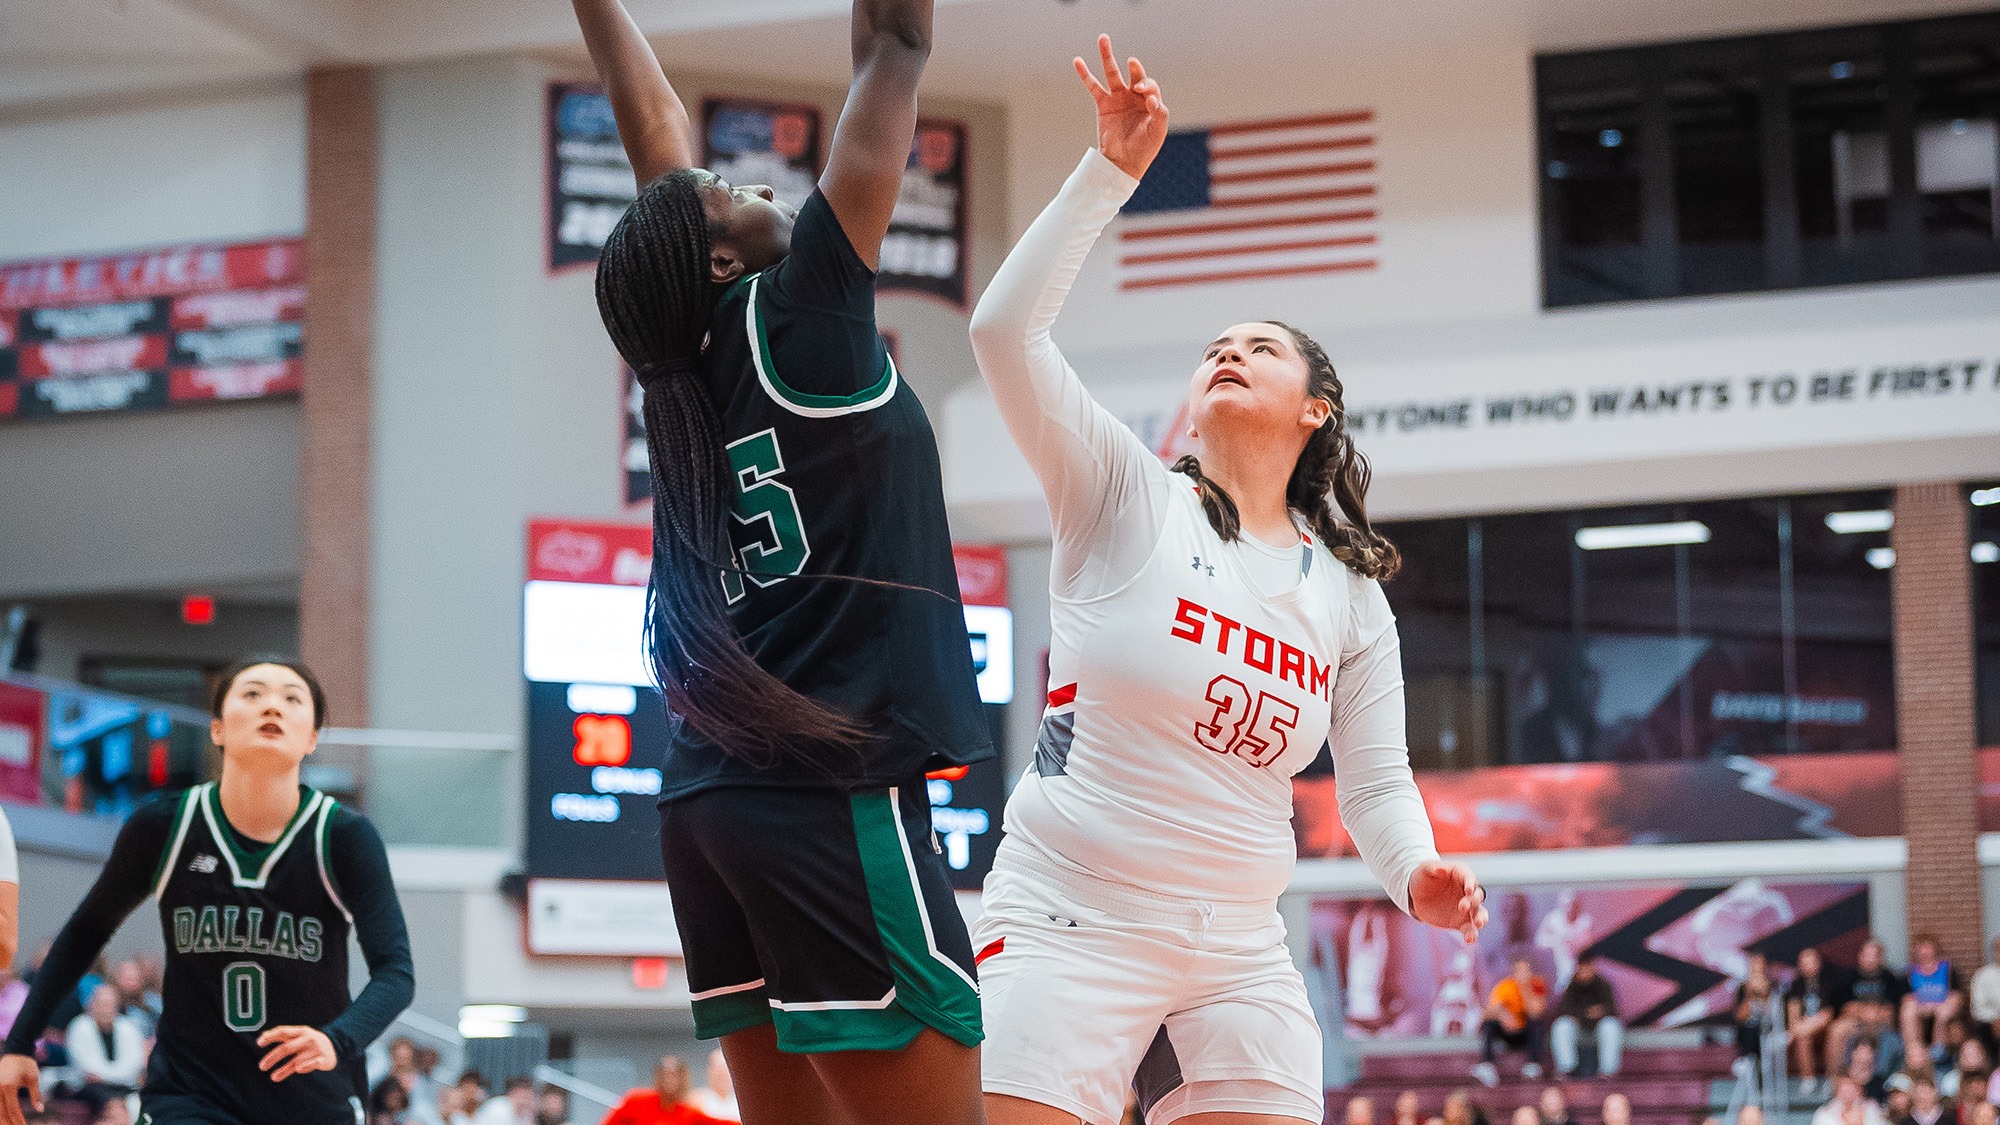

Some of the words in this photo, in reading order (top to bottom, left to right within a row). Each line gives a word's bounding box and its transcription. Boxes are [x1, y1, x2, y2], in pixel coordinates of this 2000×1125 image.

[1345, 400, 1471, 433] NYONE
[1486, 391, 1577, 424] WHO
[1588, 380, 1732, 417] WANTS
[1747, 373, 1798, 404] TO
[1808, 370, 1856, 401] BE
[1867, 359, 1984, 395] FIRST
[1170, 597, 1331, 702] STORM
[1194, 674, 1300, 768] 35
[174, 906, 323, 963] DALLAS
[223, 961, 266, 1032] 0
